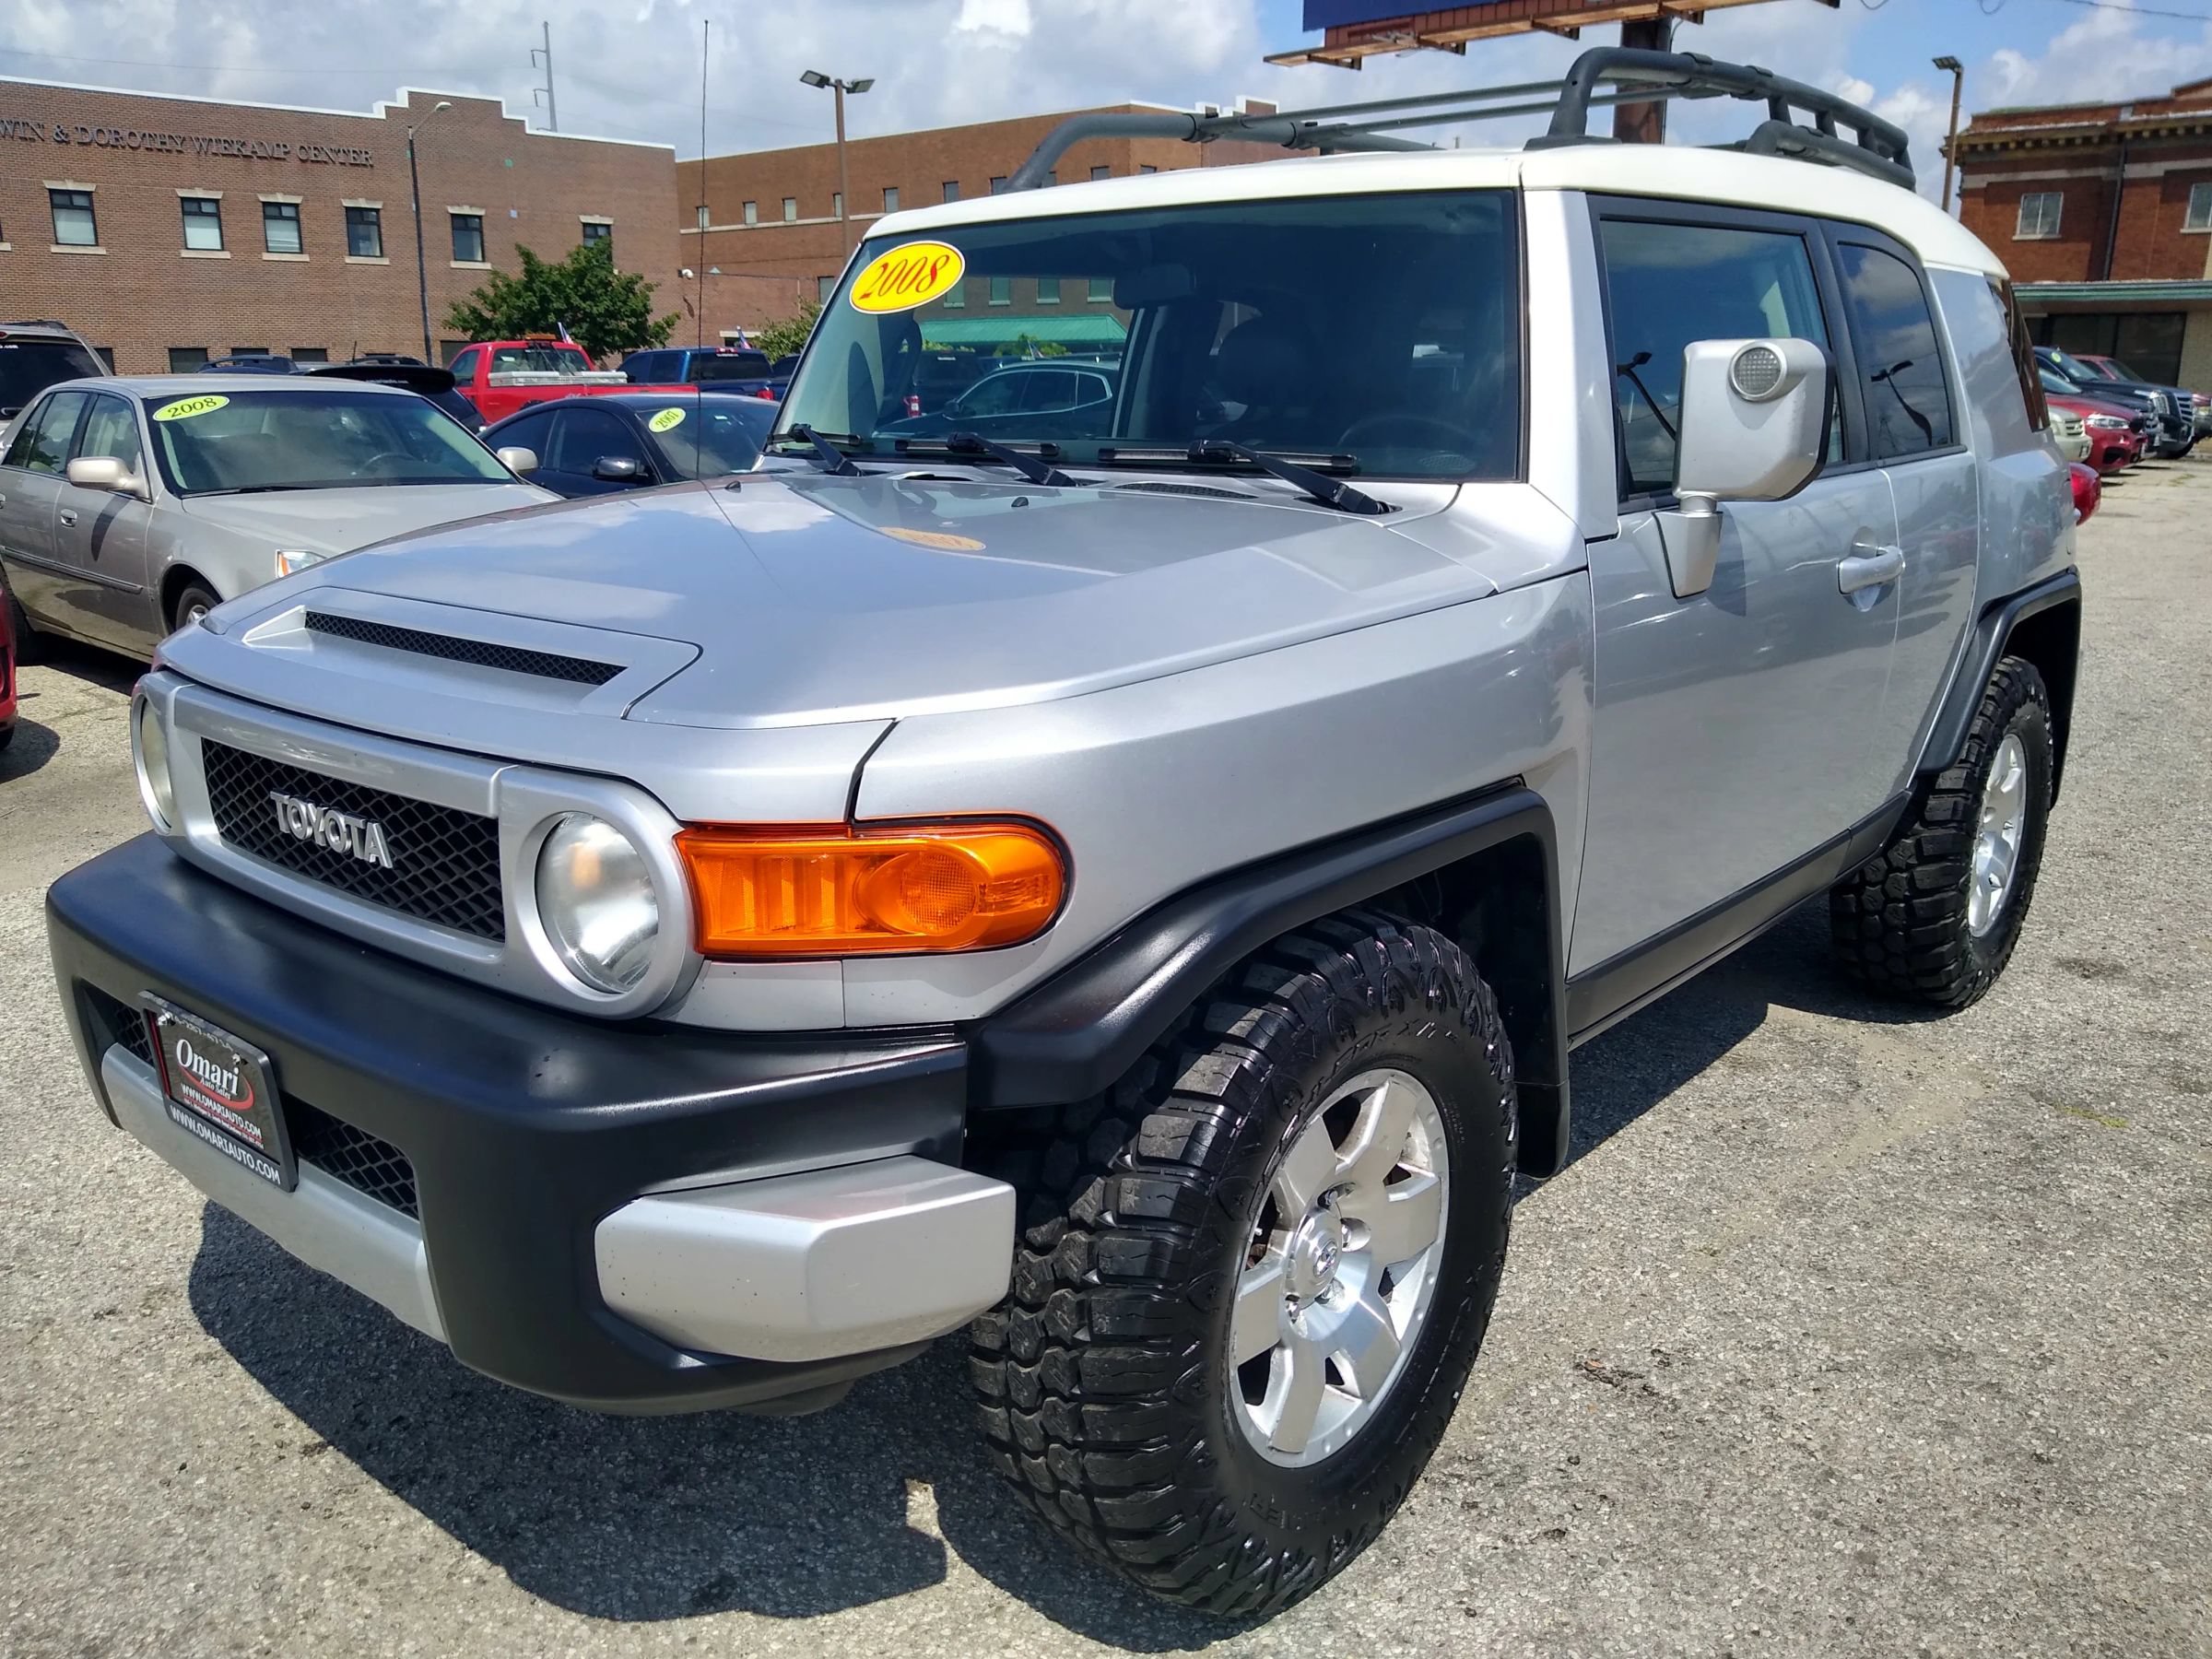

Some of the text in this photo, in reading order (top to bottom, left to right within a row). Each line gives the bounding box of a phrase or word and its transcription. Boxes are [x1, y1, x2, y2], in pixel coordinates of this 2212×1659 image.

[53, 123, 70, 144] &
[75, 125, 185, 154] DOROTHY
[190, 135, 290, 160] WIEKAMP
[296, 146, 375, 169] CENTER
[859, 254, 949, 300] 2008
[168, 397, 217, 418] 2008
[270, 791, 394, 869] TOYOTA
[176, 1039, 239, 1096] Omari
[200, 1077, 231, 1100] Auto Sales
[181, 1083, 263, 1139] WWW.OMARIAUTO.COM
[170, 1105, 281, 1185] WWW.OMARIAUTO.COM
